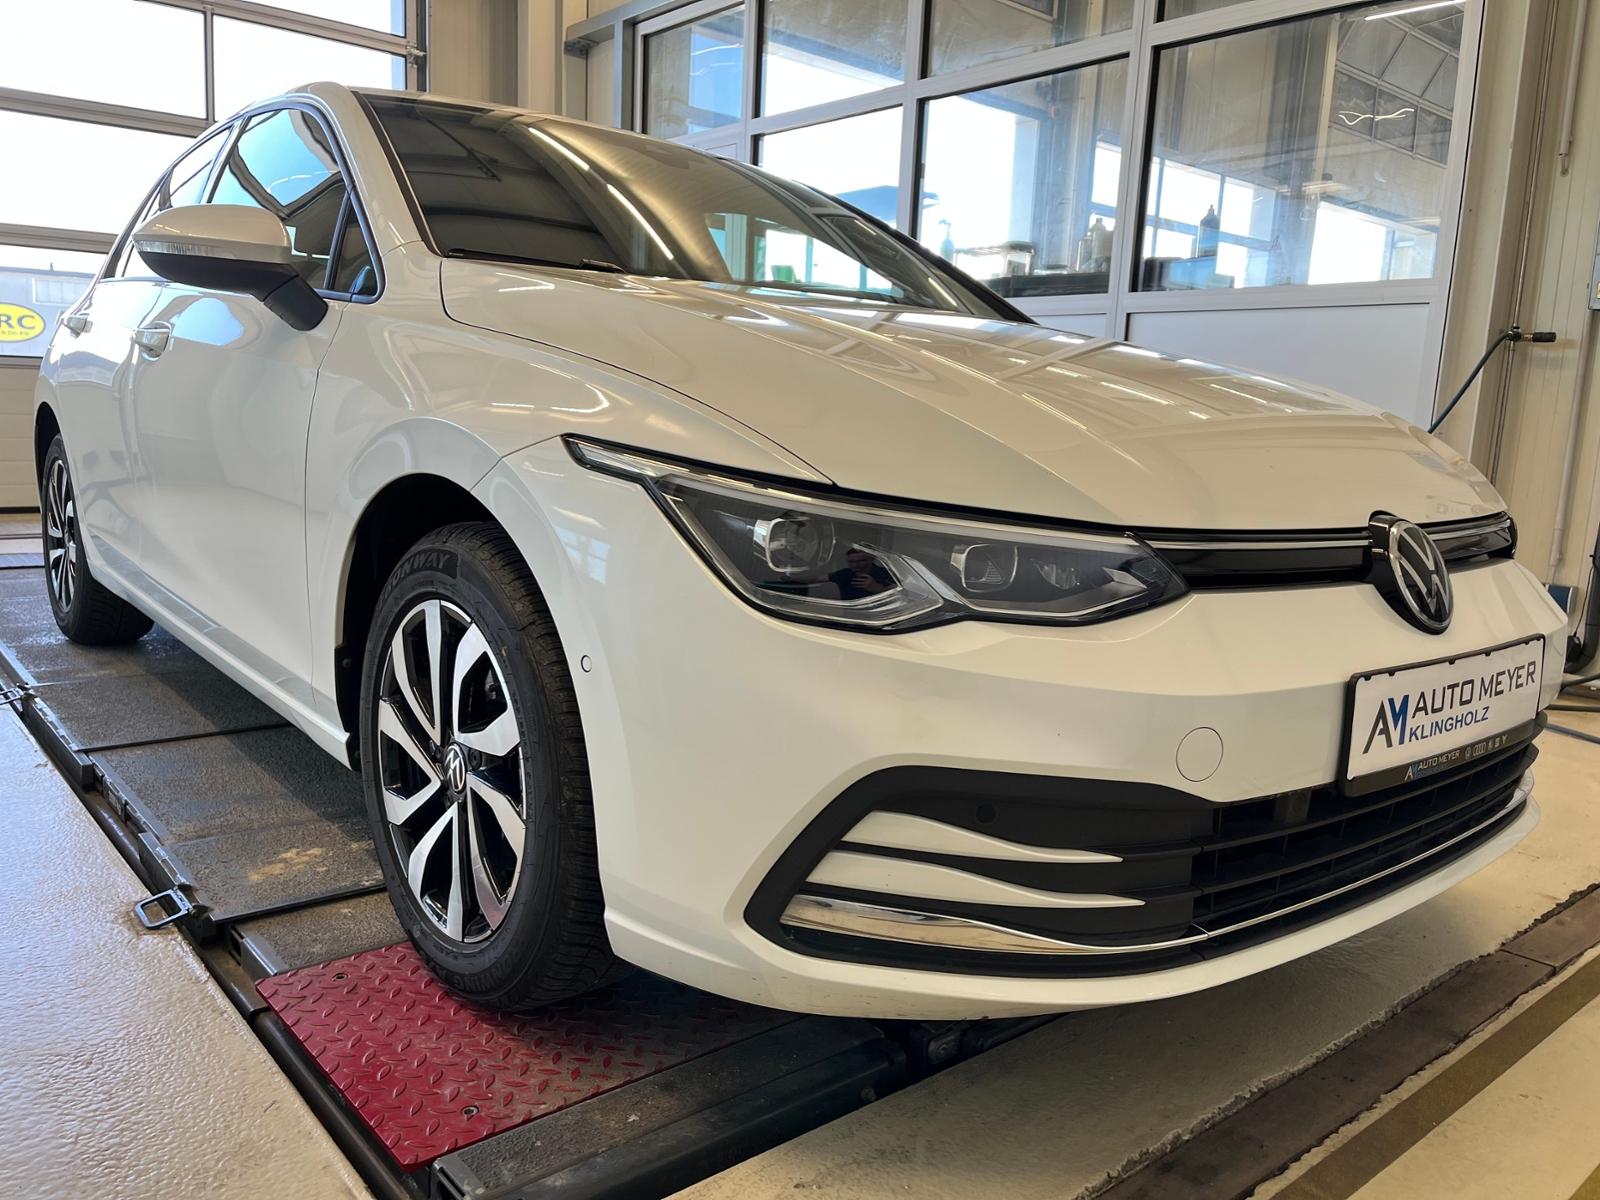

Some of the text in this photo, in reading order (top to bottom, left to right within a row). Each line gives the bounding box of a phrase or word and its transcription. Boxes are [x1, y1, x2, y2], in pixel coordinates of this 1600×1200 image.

[1412, 661, 1536, 719] AUTO MEYER
[1408, 706, 1489, 742] KLINGHOLZ
[1418, 757, 1438, 770] AUTO
[1438, 750, 1460, 763] MEYER
